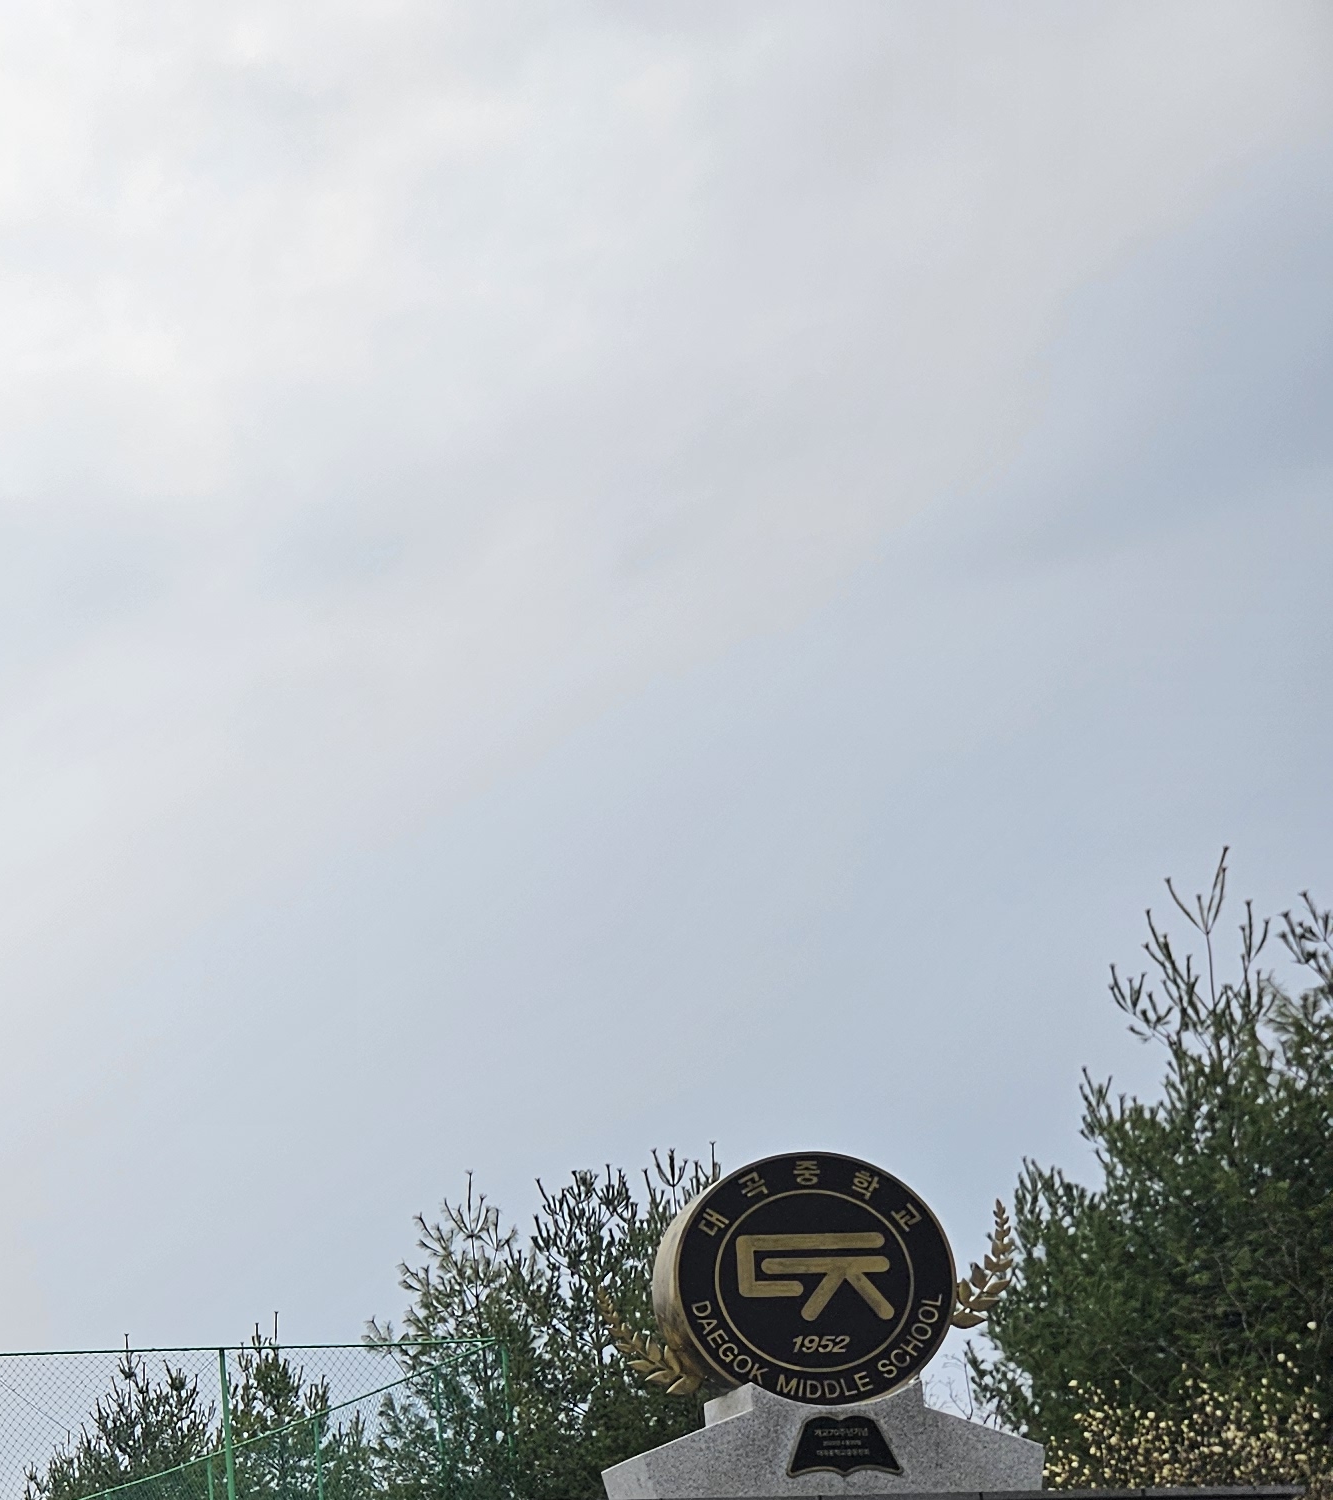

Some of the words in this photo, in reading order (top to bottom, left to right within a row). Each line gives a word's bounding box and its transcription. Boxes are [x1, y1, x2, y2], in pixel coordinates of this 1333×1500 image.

[698, 1160, 922, 1236] 대곡중학교
[691, 1301, 769, 1385] DAEGOK
[776, 1372, 874, 1398] MIDDLE
[878, 1294, 943, 1379] SCHOOL
[792, 1336, 850, 1353] 1952
